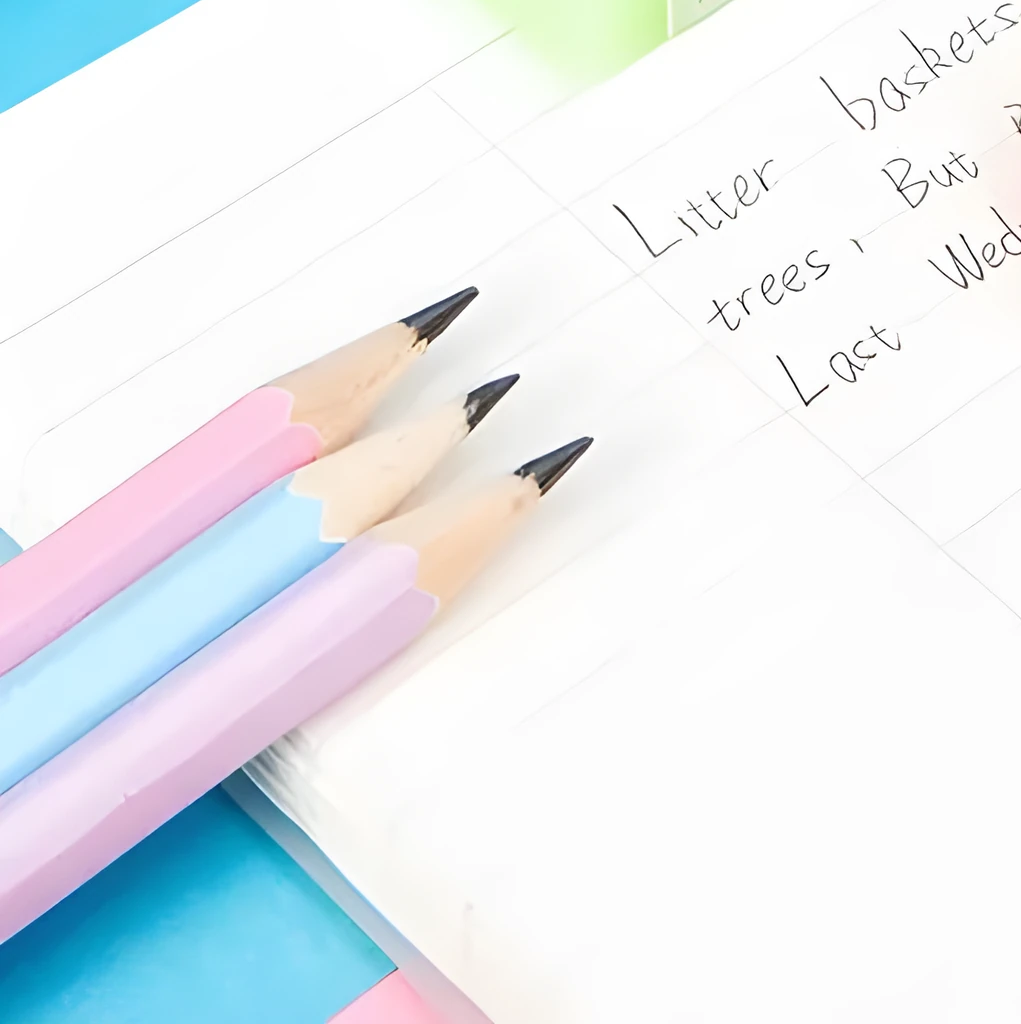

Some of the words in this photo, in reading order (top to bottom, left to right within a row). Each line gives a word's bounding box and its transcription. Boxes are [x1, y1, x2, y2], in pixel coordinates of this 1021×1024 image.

[613, 159, 773, 258] Litter
[819, 2, 1019, 131] baskets
[881, 150, 979, 208] But
[776, 325, 902, 407] Last
